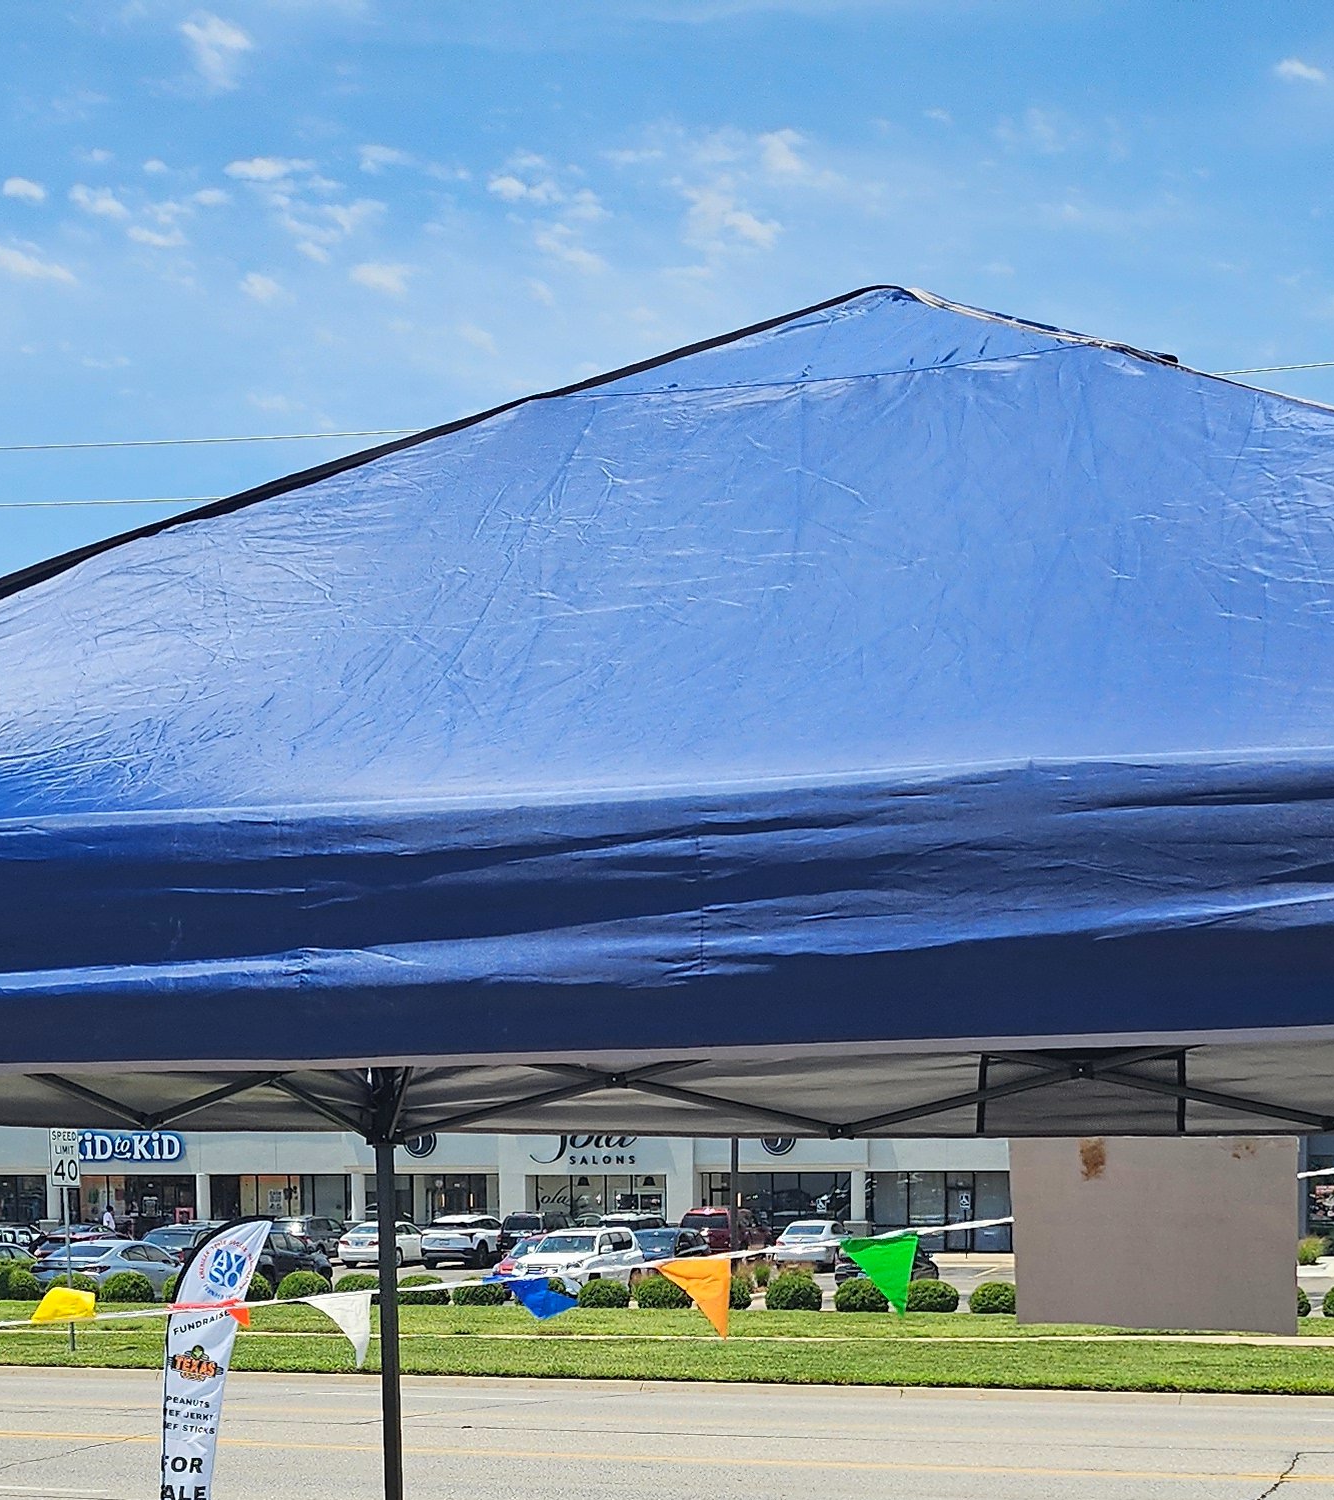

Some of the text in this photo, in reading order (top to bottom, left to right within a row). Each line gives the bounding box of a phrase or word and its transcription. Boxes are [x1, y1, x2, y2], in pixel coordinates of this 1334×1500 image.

[52, 1131, 76, 1141] SPEED
[55, 1146, 74, 1155] LIMIT
[115, 1136, 130, 1152] to
[569, 1155, 636, 1165] SALONS
[54, 1159, 77, 1181] 40
[173, 1310, 231, 1335] FUNDRAISE
[175, 1354, 216, 1377] TEXAS
[167, 1395, 210, 1408] PEANUTS
[182, 1424, 215, 1435] STICKS
